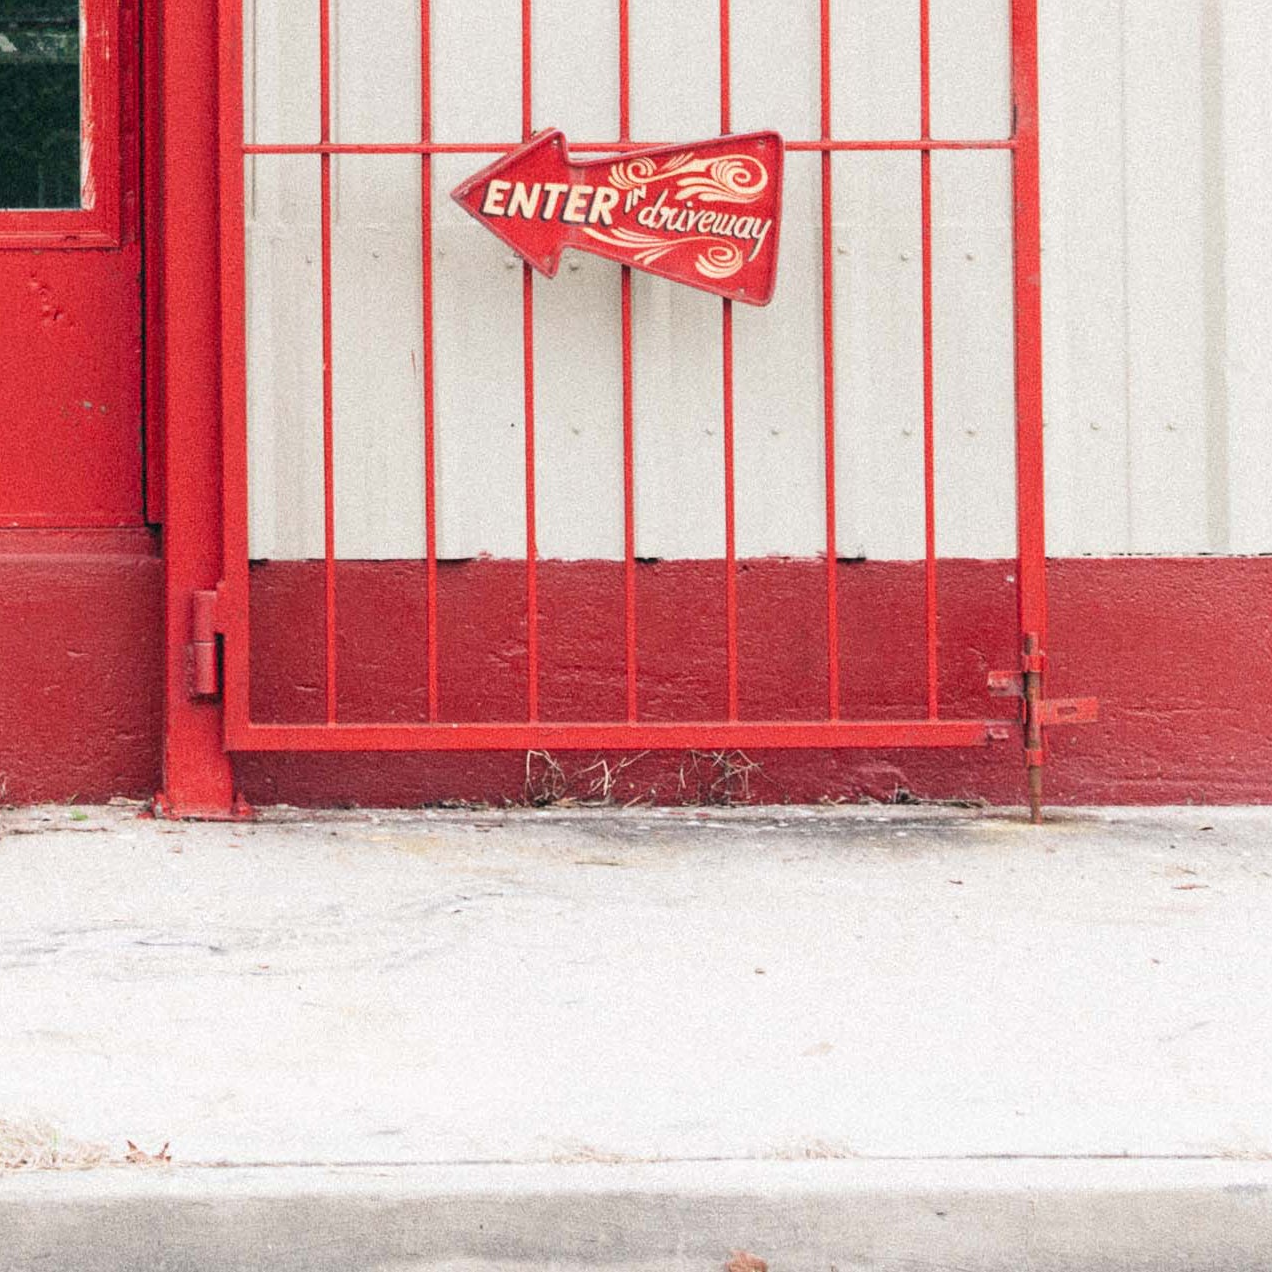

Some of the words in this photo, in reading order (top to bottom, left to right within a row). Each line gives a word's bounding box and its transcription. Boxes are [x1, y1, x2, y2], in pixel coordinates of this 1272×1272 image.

[479, 178, 620, 227] ENTER
[623, 184, 647, 214] IN
[636, 188, 773, 263] driveway
